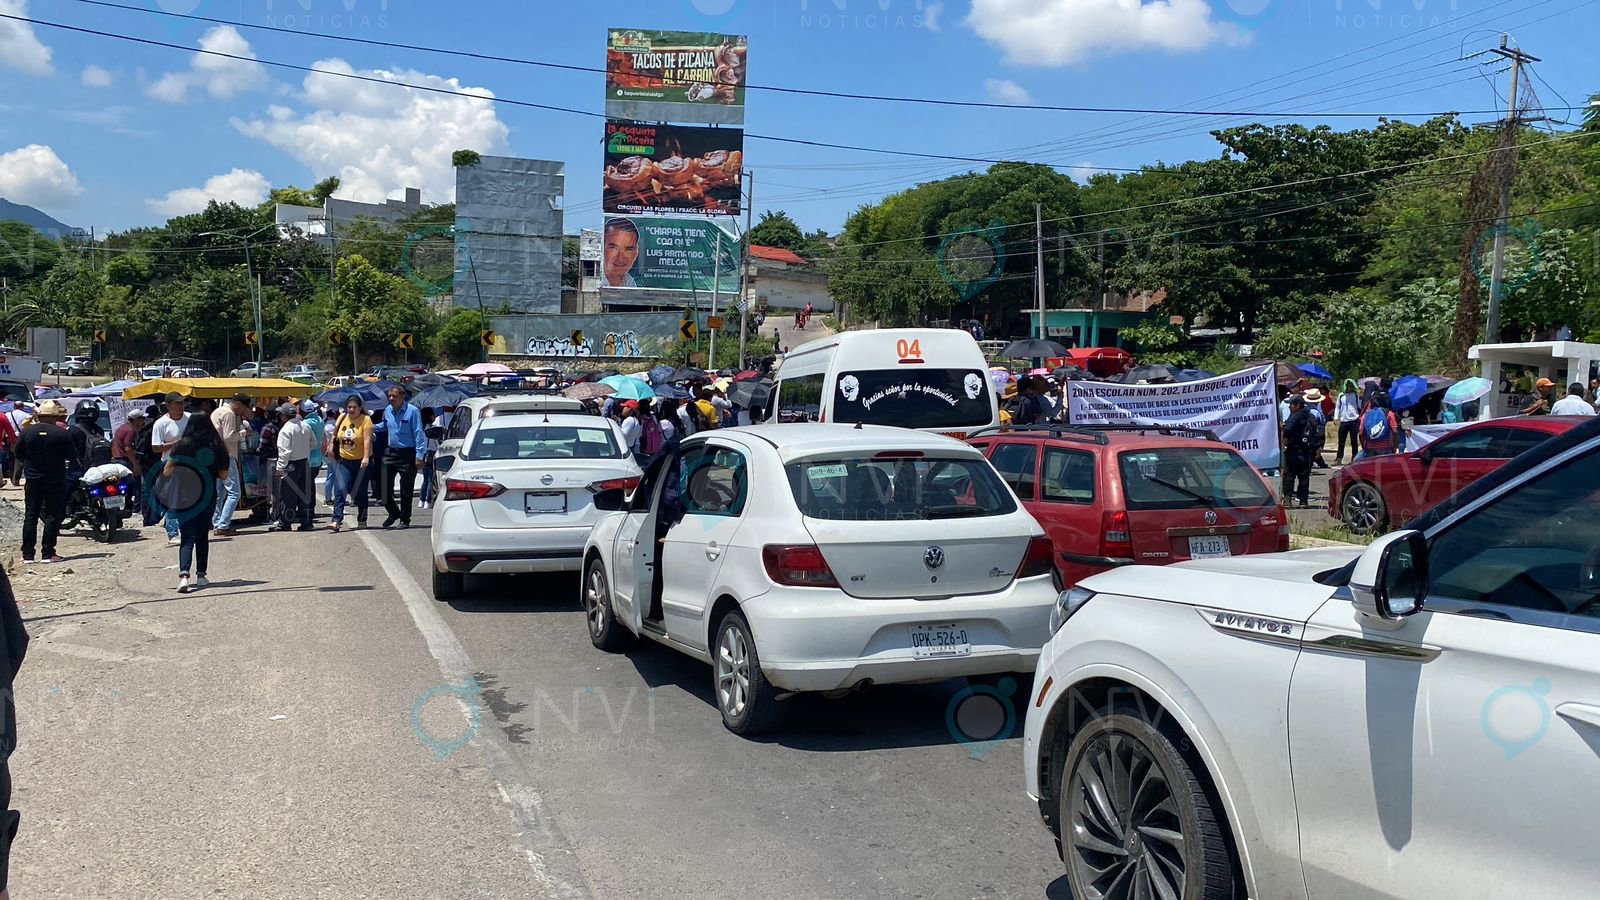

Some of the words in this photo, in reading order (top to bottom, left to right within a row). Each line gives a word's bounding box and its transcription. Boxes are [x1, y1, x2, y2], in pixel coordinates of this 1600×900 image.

[632, 53, 662, 69] TACOS
[664, 52, 676, 68] DE
[678, 50, 715, 68] PICAÑA
[663, 69, 675, 84] AL
[677, 67, 715, 84] CARBÓN
[619, 126, 657, 137] esquina
[627, 135, 657, 146] Picaña
[684, 228, 706, 238] TIENE
[646, 249, 663, 257] LUIS
[664, 249, 704, 259] ARMANDO
[896, 338, 921, 358] 04
[1072, 388, 1095, 398] ZONA
[1096, 388, 1135, 397] ESCOLAR
[1137, 387, 1159, 397] NUM.
[1182, 385, 1193, 394] EL
[1230, 373, 1267, 387] CHIAPAS
[862, 390, 885, 411] Gracias
[885, 384, 901, 396] señor
[902, 383, 913, 393] por
[914, 382, 921, 391] la
[922, 385, 960, 406] oportunidad
[1088, 402, 1116, 411] EXIGIMOS
[1117, 401, 1147, 410] MAESTROS
[1148, 401, 1155, 409] DE
[1155, 400, 1170, 408] BASE
[1171, 399, 1179, 407] EN
[1191, 395, 1221, 404] ESCUELAS
[1221, 393, 1232, 401] QUE
[1243, 389, 1268, 398] CUENTAN
[1075, 412, 1087, 421] CON
[1087, 411, 1119, 420] MAESTROS
[1119, 411, 1128, 419] EN
[1128, 411, 1139, 419] LOS
[1140, 410, 1162, 418] NIVELES
[1204, 402, 1234, 413] PRIMARIA
[1239, 398, 1273, 409] PREESCOLAR
[1190, 418, 1221, 428] INTERINOS
[1221, 417, 1232, 426] QUE
[1232, 413, 1270, 424] TRABAJARON
[1227, 439, 1259, 451] DIATA
[1214, 612, 1293, 635] AVIATOR
[911, 630, 968, 648] DPK-526-D
